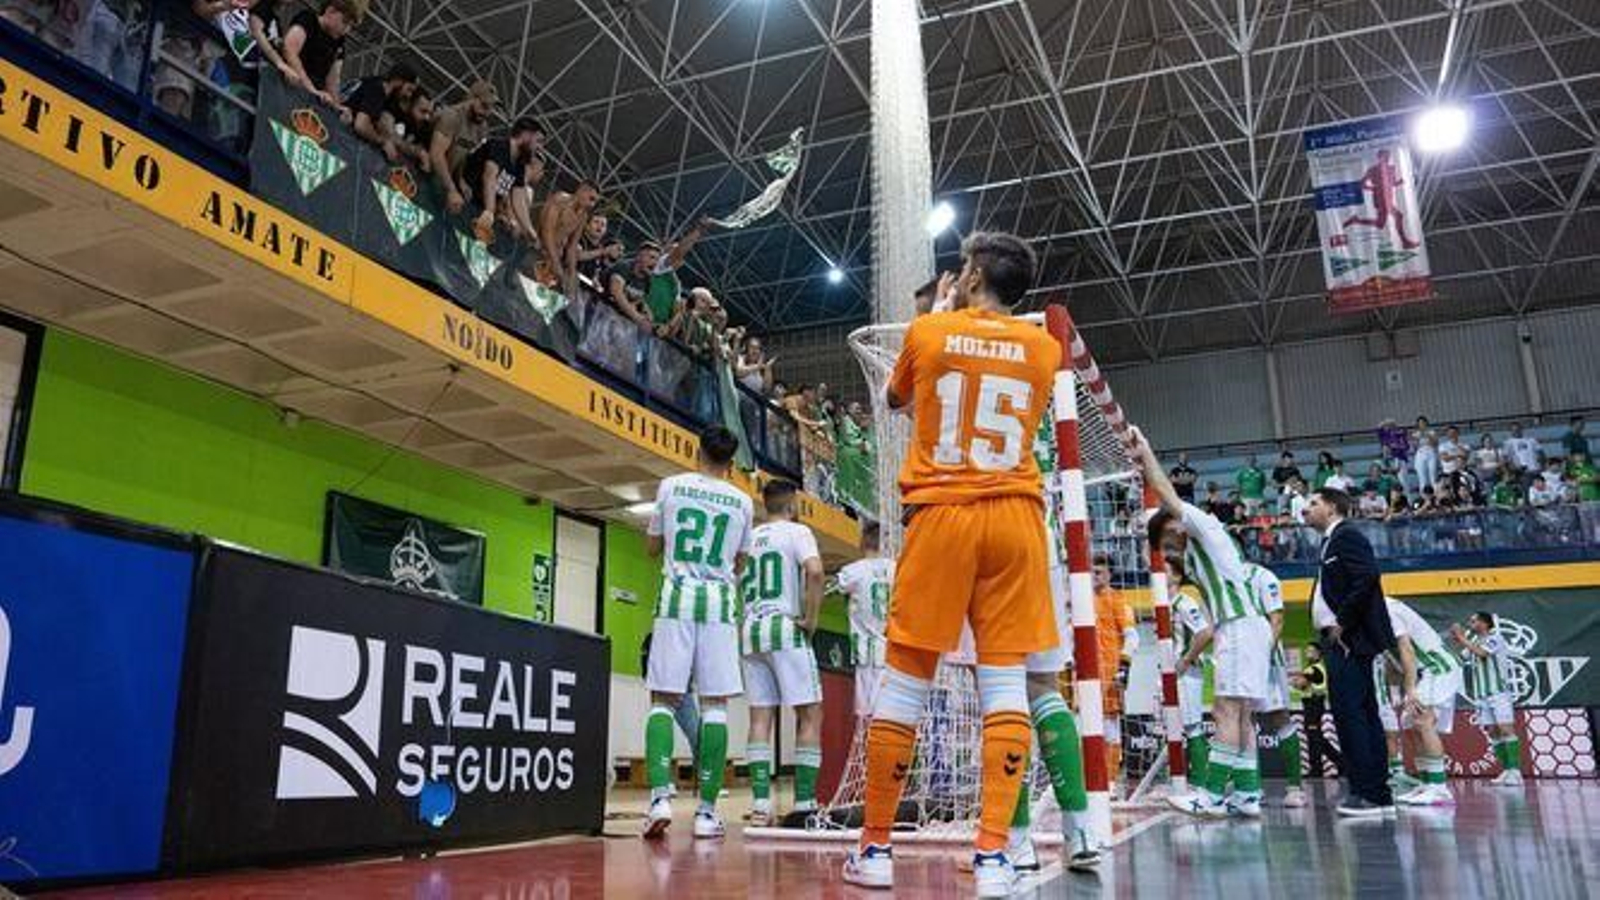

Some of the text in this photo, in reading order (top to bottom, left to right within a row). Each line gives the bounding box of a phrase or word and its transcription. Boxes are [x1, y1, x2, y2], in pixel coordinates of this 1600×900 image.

[200, 190, 336, 281] AMATE
[944, 334, 1026, 363] MOLINA
[588, 390, 694, 459] INSTITUTO
[933, 370, 1033, 470] 15
[673, 507, 730, 567] 21
[740, 551, 783, 602] 20
[402, 644, 576, 734] REALE
